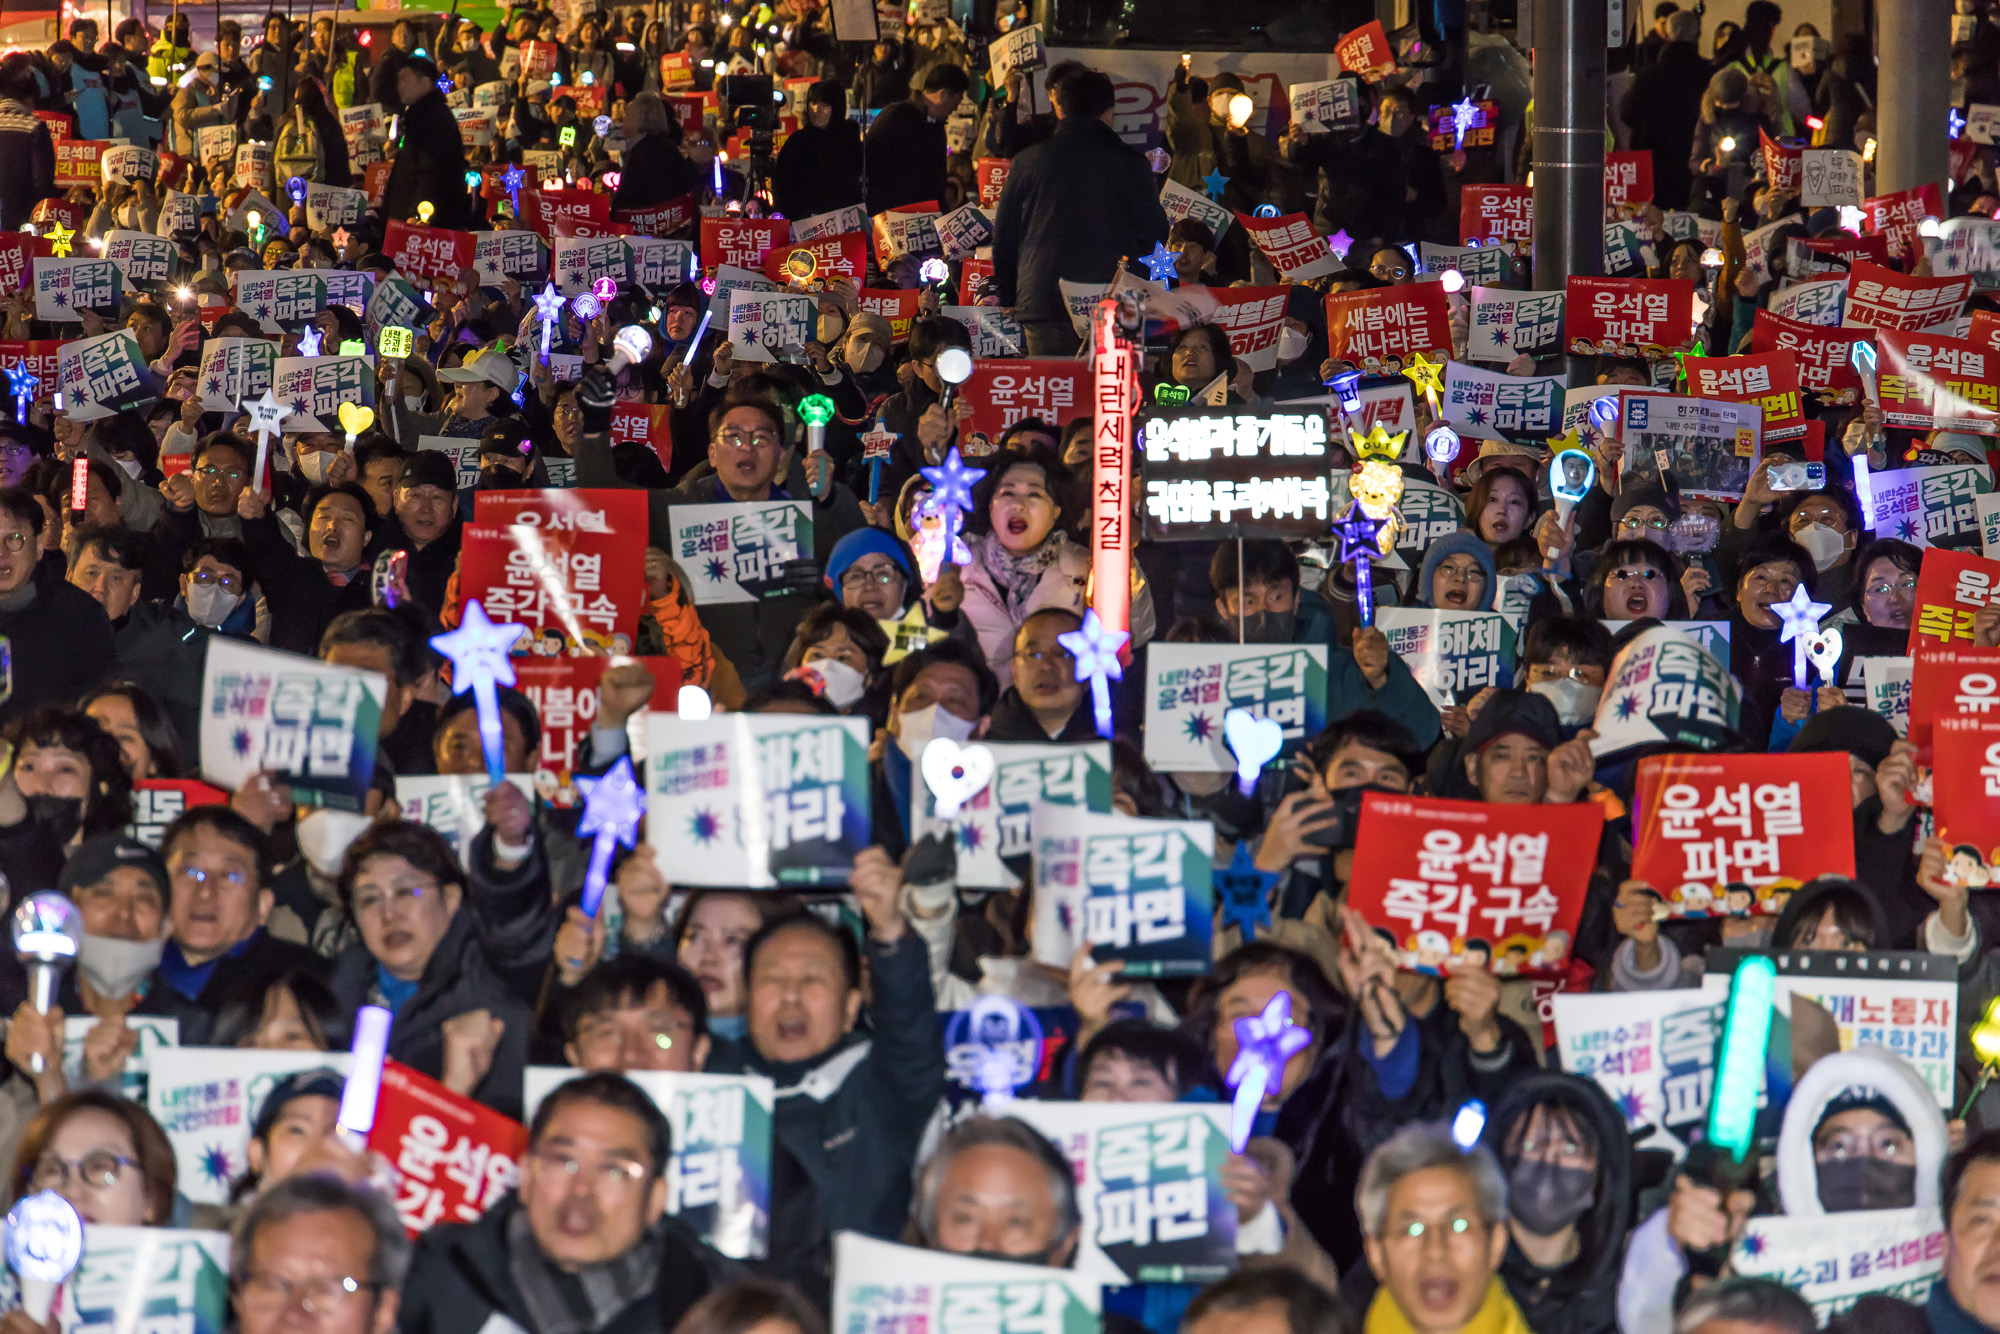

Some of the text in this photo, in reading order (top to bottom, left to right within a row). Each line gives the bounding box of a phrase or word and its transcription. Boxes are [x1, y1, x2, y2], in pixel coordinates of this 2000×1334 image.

[1008, 46, 1038, 67] 하라
[1342, 33, 1374, 64] 윤석열
[1318, 82, 1349, 103] 즉각
[1319, 101, 1352, 122] 파면
[57, 146, 96, 160] 윤석열
[717, 229, 772, 250] 윤석열
[1490, 218, 1533, 241] 파면
[133, 241, 172, 261] 즉각
[406, 236, 455, 256] 윤석열
[503, 235, 538, 254] 즉각
[588, 241, 627, 262] 즉각
[647, 243, 683, 264] 즉각
[808, 241, 843, 259] 석열
[130, 261, 169, 280] 파면
[394, 252, 461, 281] 즉각 구속
[503, 255, 538, 274] 파면
[725, 249, 764, 269] 파면
[817, 259, 855, 277] 구속
[1459, 252, 1501, 272] 즉각
[40, 277, 70, 291] 윤석열
[74, 262, 114, 285] 즉각
[277, 274, 319, 297] 즉각
[644, 265, 682, 285] 파면
[74, 285, 112, 308] 파면
[242, 288, 273, 303] 윤석열
[243, 279, 274, 294] 내란수괴
[1854, 280, 1967, 309] 윤석열을
[275, 297, 316, 320] 파면
[732, 302, 763, 314] 내란동조
[764, 300, 810, 324] 해체
[857, 298, 900, 316] 석열
[1210, 294, 1287, 330] 석열을
[1345, 303, 1428, 332] 새봄에는
[1476, 311, 1513, 326] 윤석열
[1477, 302, 1515, 313] 내란수괴
[1518, 295, 1562, 322] 즉각
[1592, 292, 1668, 322] 윤석열
[1847, 302, 1962, 332] 파면하라!
[763, 323, 808, 348] 하라
[1347, 327, 1432, 357] 새나라로
[1514, 322, 1559, 349] 파면
[1603, 320, 1654, 346] 파면
[84, 336, 129, 372] 즉각
[228, 343, 272, 369] 즉각
[1775, 332, 1850, 367] 윤석열
[1906, 344, 1985, 379] 윤석열
[91, 362, 141, 402] 파면
[227, 369, 272, 396] 파면
[316, 362, 362, 388] 즉각
[1452, 379, 1495, 393] 내란수괴
[1699, 365, 1771, 396] 윤석열
[989, 376, 1075, 408] 윤석열
[1451, 390, 1494, 406] 윤석열
[1499, 381, 1553, 404] 즉각
[1880, 374, 1936, 406] 즉각
[611, 416, 649, 440] 석열
[1496, 407, 1551, 431] 파면
[1700, 423, 1720, 433] 윤석열
[1363, 442, 1391, 451] OUT
[1873, 481, 1919, 504] 내란수괴
[1923, 469, 1978, 506] 즉각
[1875, 494, 1920, 522] 윤석열
[1926, 500, 1979, 538] 파면
[679, 520, 729, 541] 내란수괴
[734, 505, 797, 548] 즉각
[681, 533, 729, 558] 윤석열
[483, 586, 546, 627] 즉각
[1440, 616, 1499, 656] 해체
[1158, 662, 1223, 688] 내란수괴
[1228, 650, 1309, 699] 즉각
[1436, 654, 1500, 692] 하라
[1158, 681, 1221, 711] 윤석열
[999, 753, 1089, 805] 즉각
[1658, 782, 1804, 839] 윤석열
[1086, 829, 1184, 888] 즉각
[1417, 829, 1548, 885] 윤석열
[1682, 836, 1781, 889] 파면
[1085, 884, 1187, 948] 파면
[1382, 877, 1559, 936] 즉각 구속
[1097, 1112, 1208, 1182] 즉각
[1096, 1176, 1209, 1248] 파면
